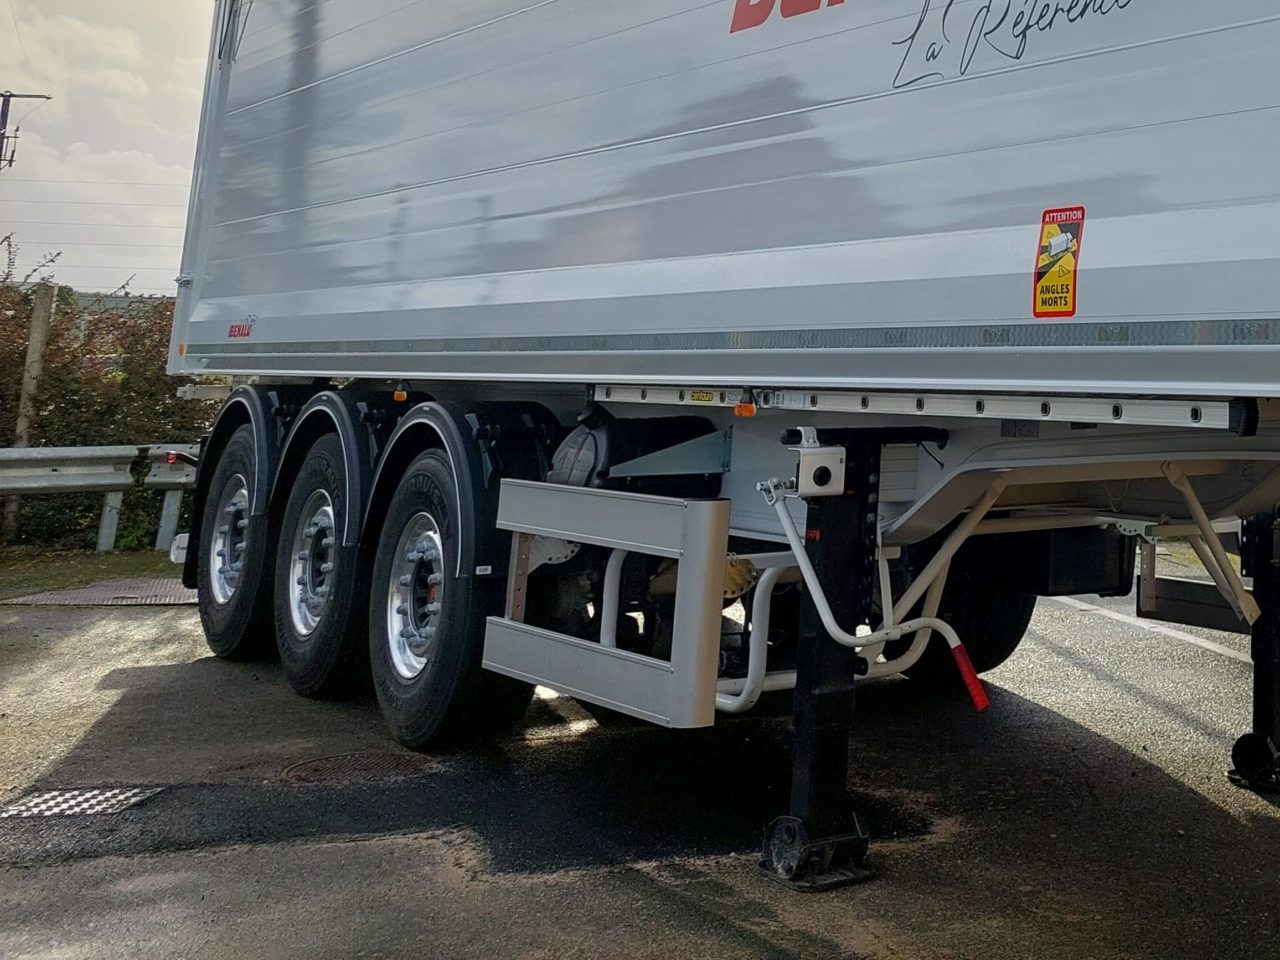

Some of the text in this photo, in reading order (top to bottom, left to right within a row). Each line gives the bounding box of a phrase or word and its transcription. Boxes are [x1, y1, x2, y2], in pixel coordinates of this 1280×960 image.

[1045, 210, 1083, 223] ATTENTION
[1040, 284, 1070, 295] ANGLES
[1041, 296, 1068, 307] MORTS
